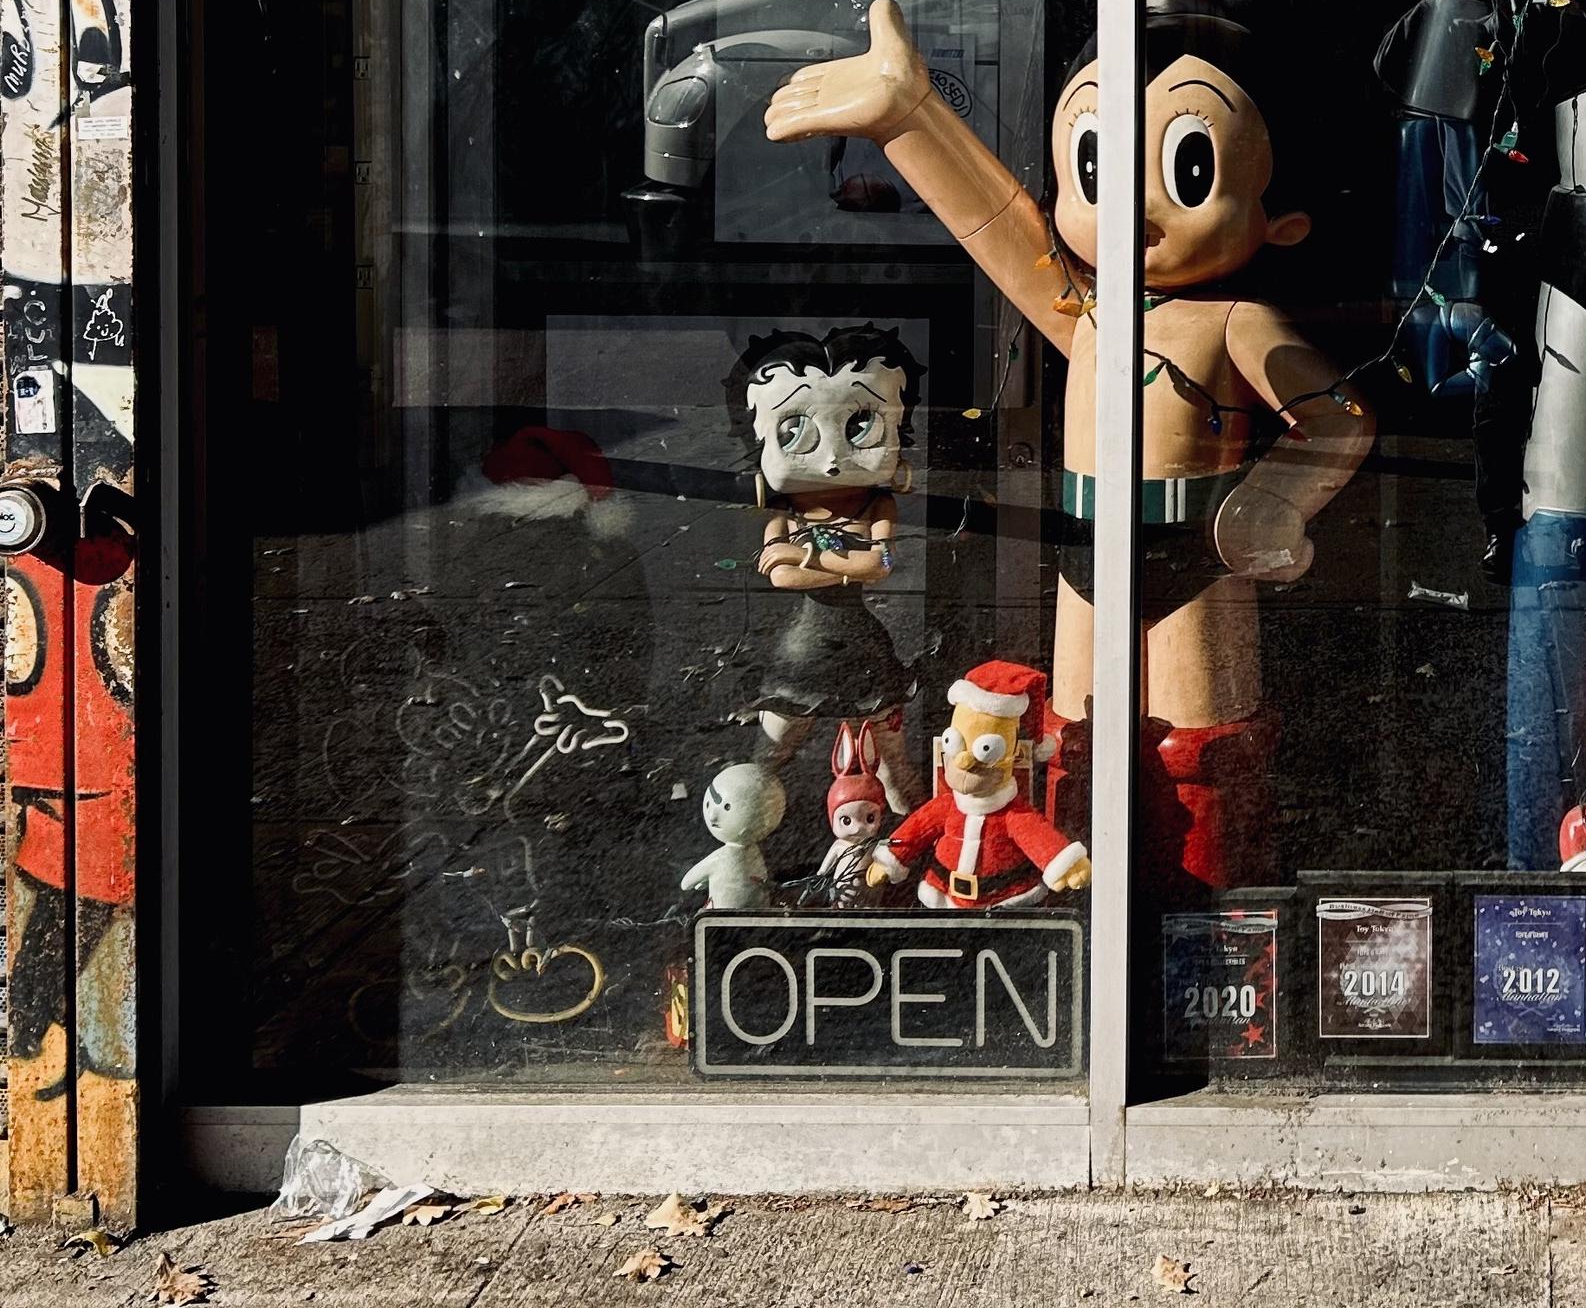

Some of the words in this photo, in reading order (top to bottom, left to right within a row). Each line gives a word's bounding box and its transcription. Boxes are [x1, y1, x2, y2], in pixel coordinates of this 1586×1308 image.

[1343, 970, 1405, 997] 2014
[1502, 968, 1560, 993] 2012
[721, 946, 1058, 1049] OPEN
[1183, 984, 1257, 1019] 2020
